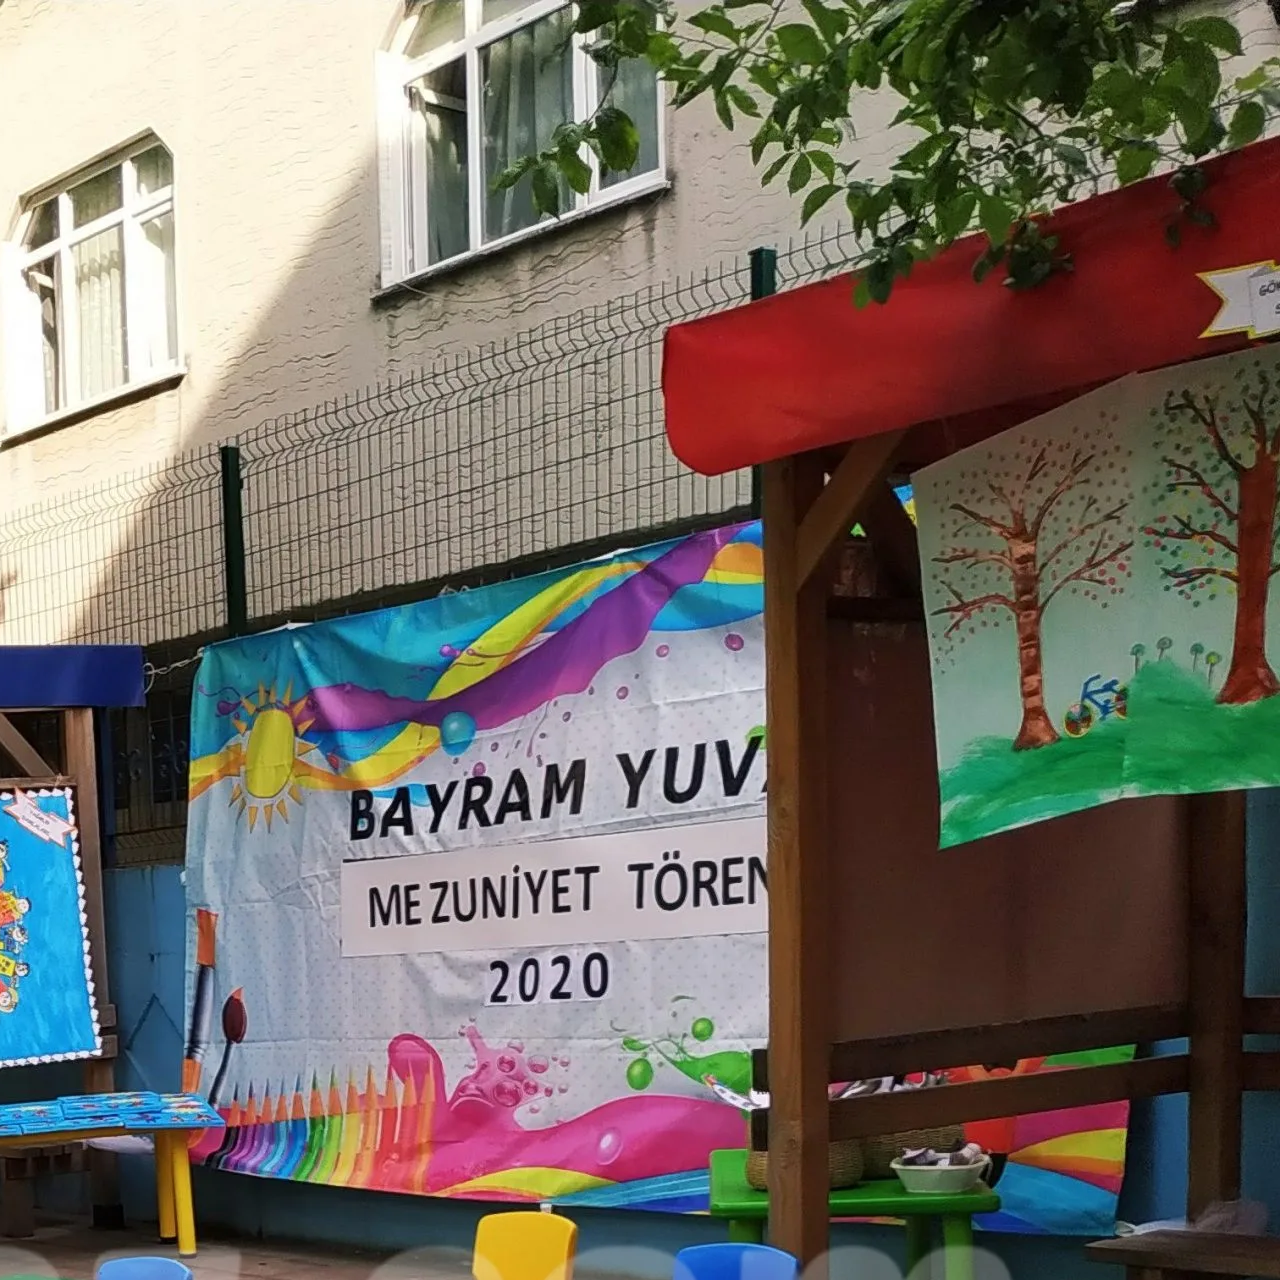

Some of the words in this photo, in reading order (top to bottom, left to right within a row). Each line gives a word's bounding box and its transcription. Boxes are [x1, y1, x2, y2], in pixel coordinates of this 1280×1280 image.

[350, 759, 587, 841] BAYRAM
[616, 735, 767, 809] YUV
[368, 864, 600, 928] MEZUNİYET
[489, 951, 609, 1003] 2020
